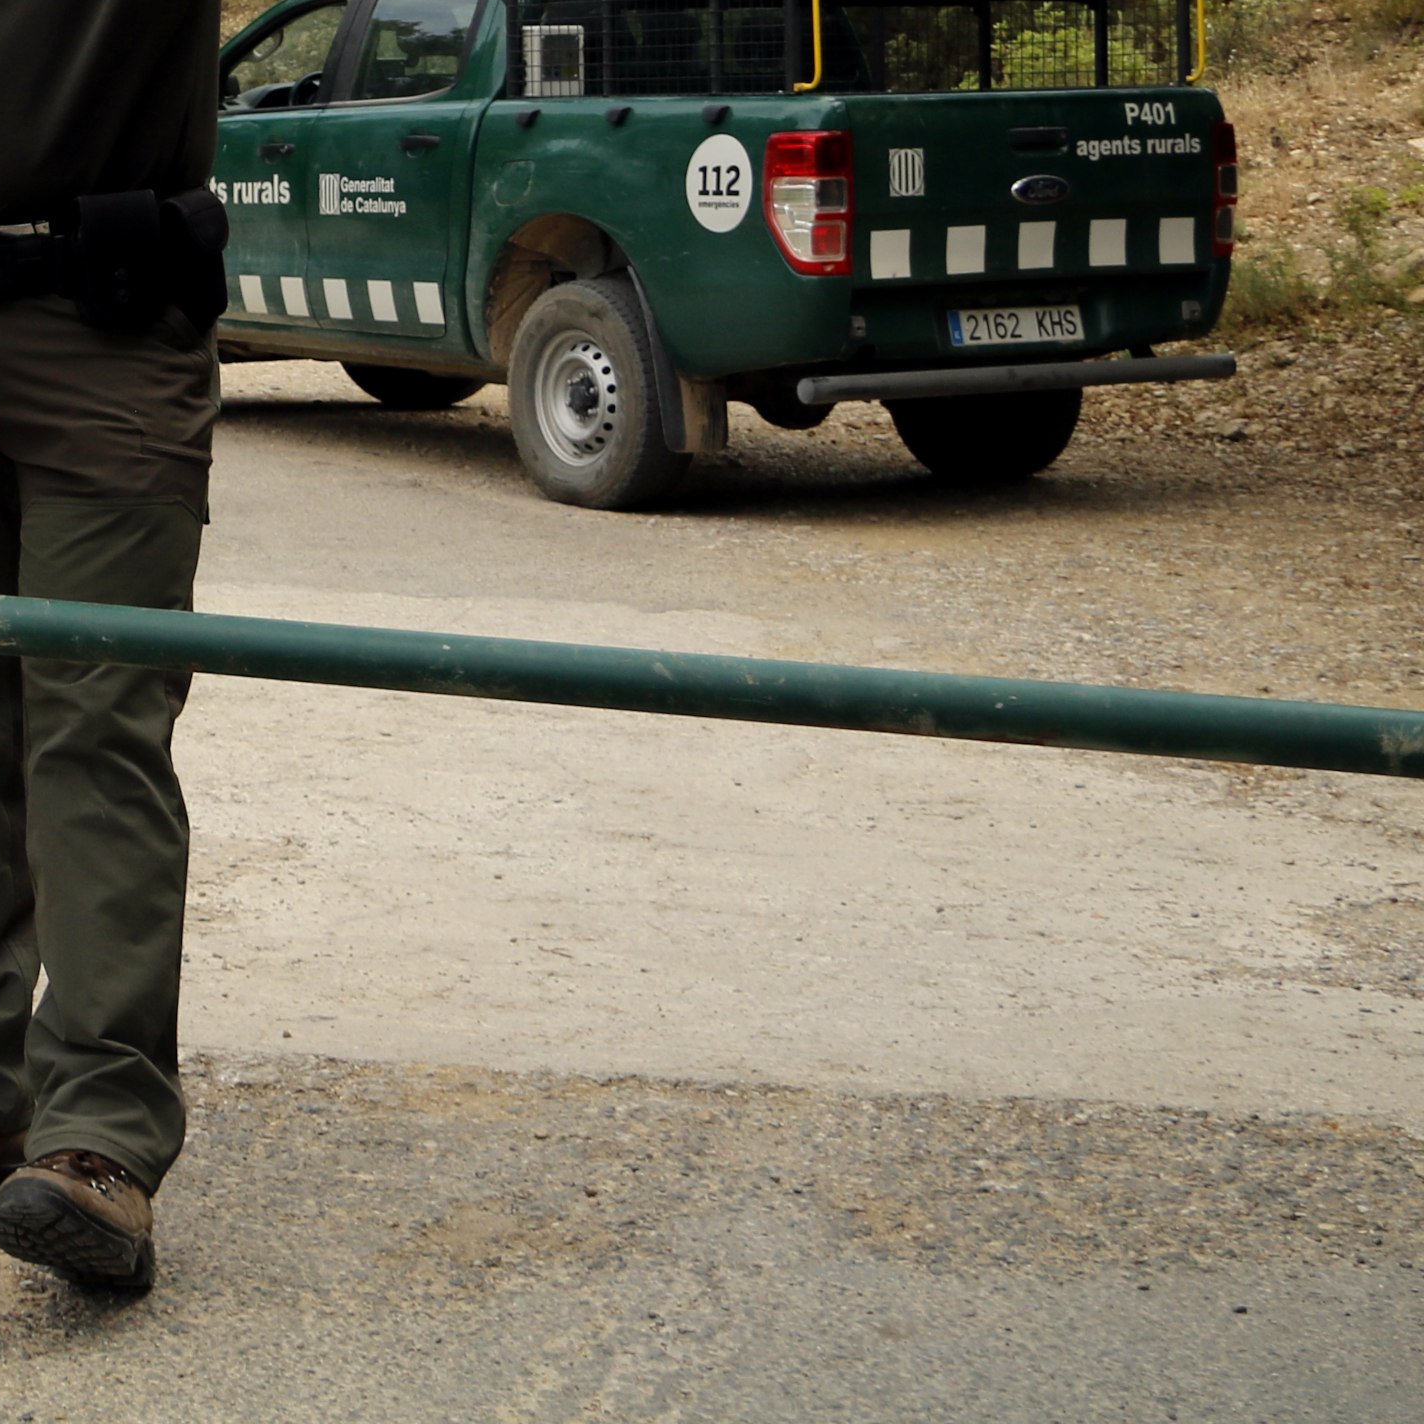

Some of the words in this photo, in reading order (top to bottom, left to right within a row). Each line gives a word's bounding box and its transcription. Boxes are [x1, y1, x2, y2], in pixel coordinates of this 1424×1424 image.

[1124, 102, 1177, 125] P401
[1076, 134, 1142, 161] agents
[1146, 133, 1201, 154] rurals
[232, 173, 291, 204] rurals
[340, 176, 394, 193] Generalitat
[698, 164, 740, 196] 112
[340, 197, 353, 213] de
[355, 197, 407, 217] Catalunya
[966, 312, 1022, 341] 2162
[1035, 309, 1077, 338] KHS
